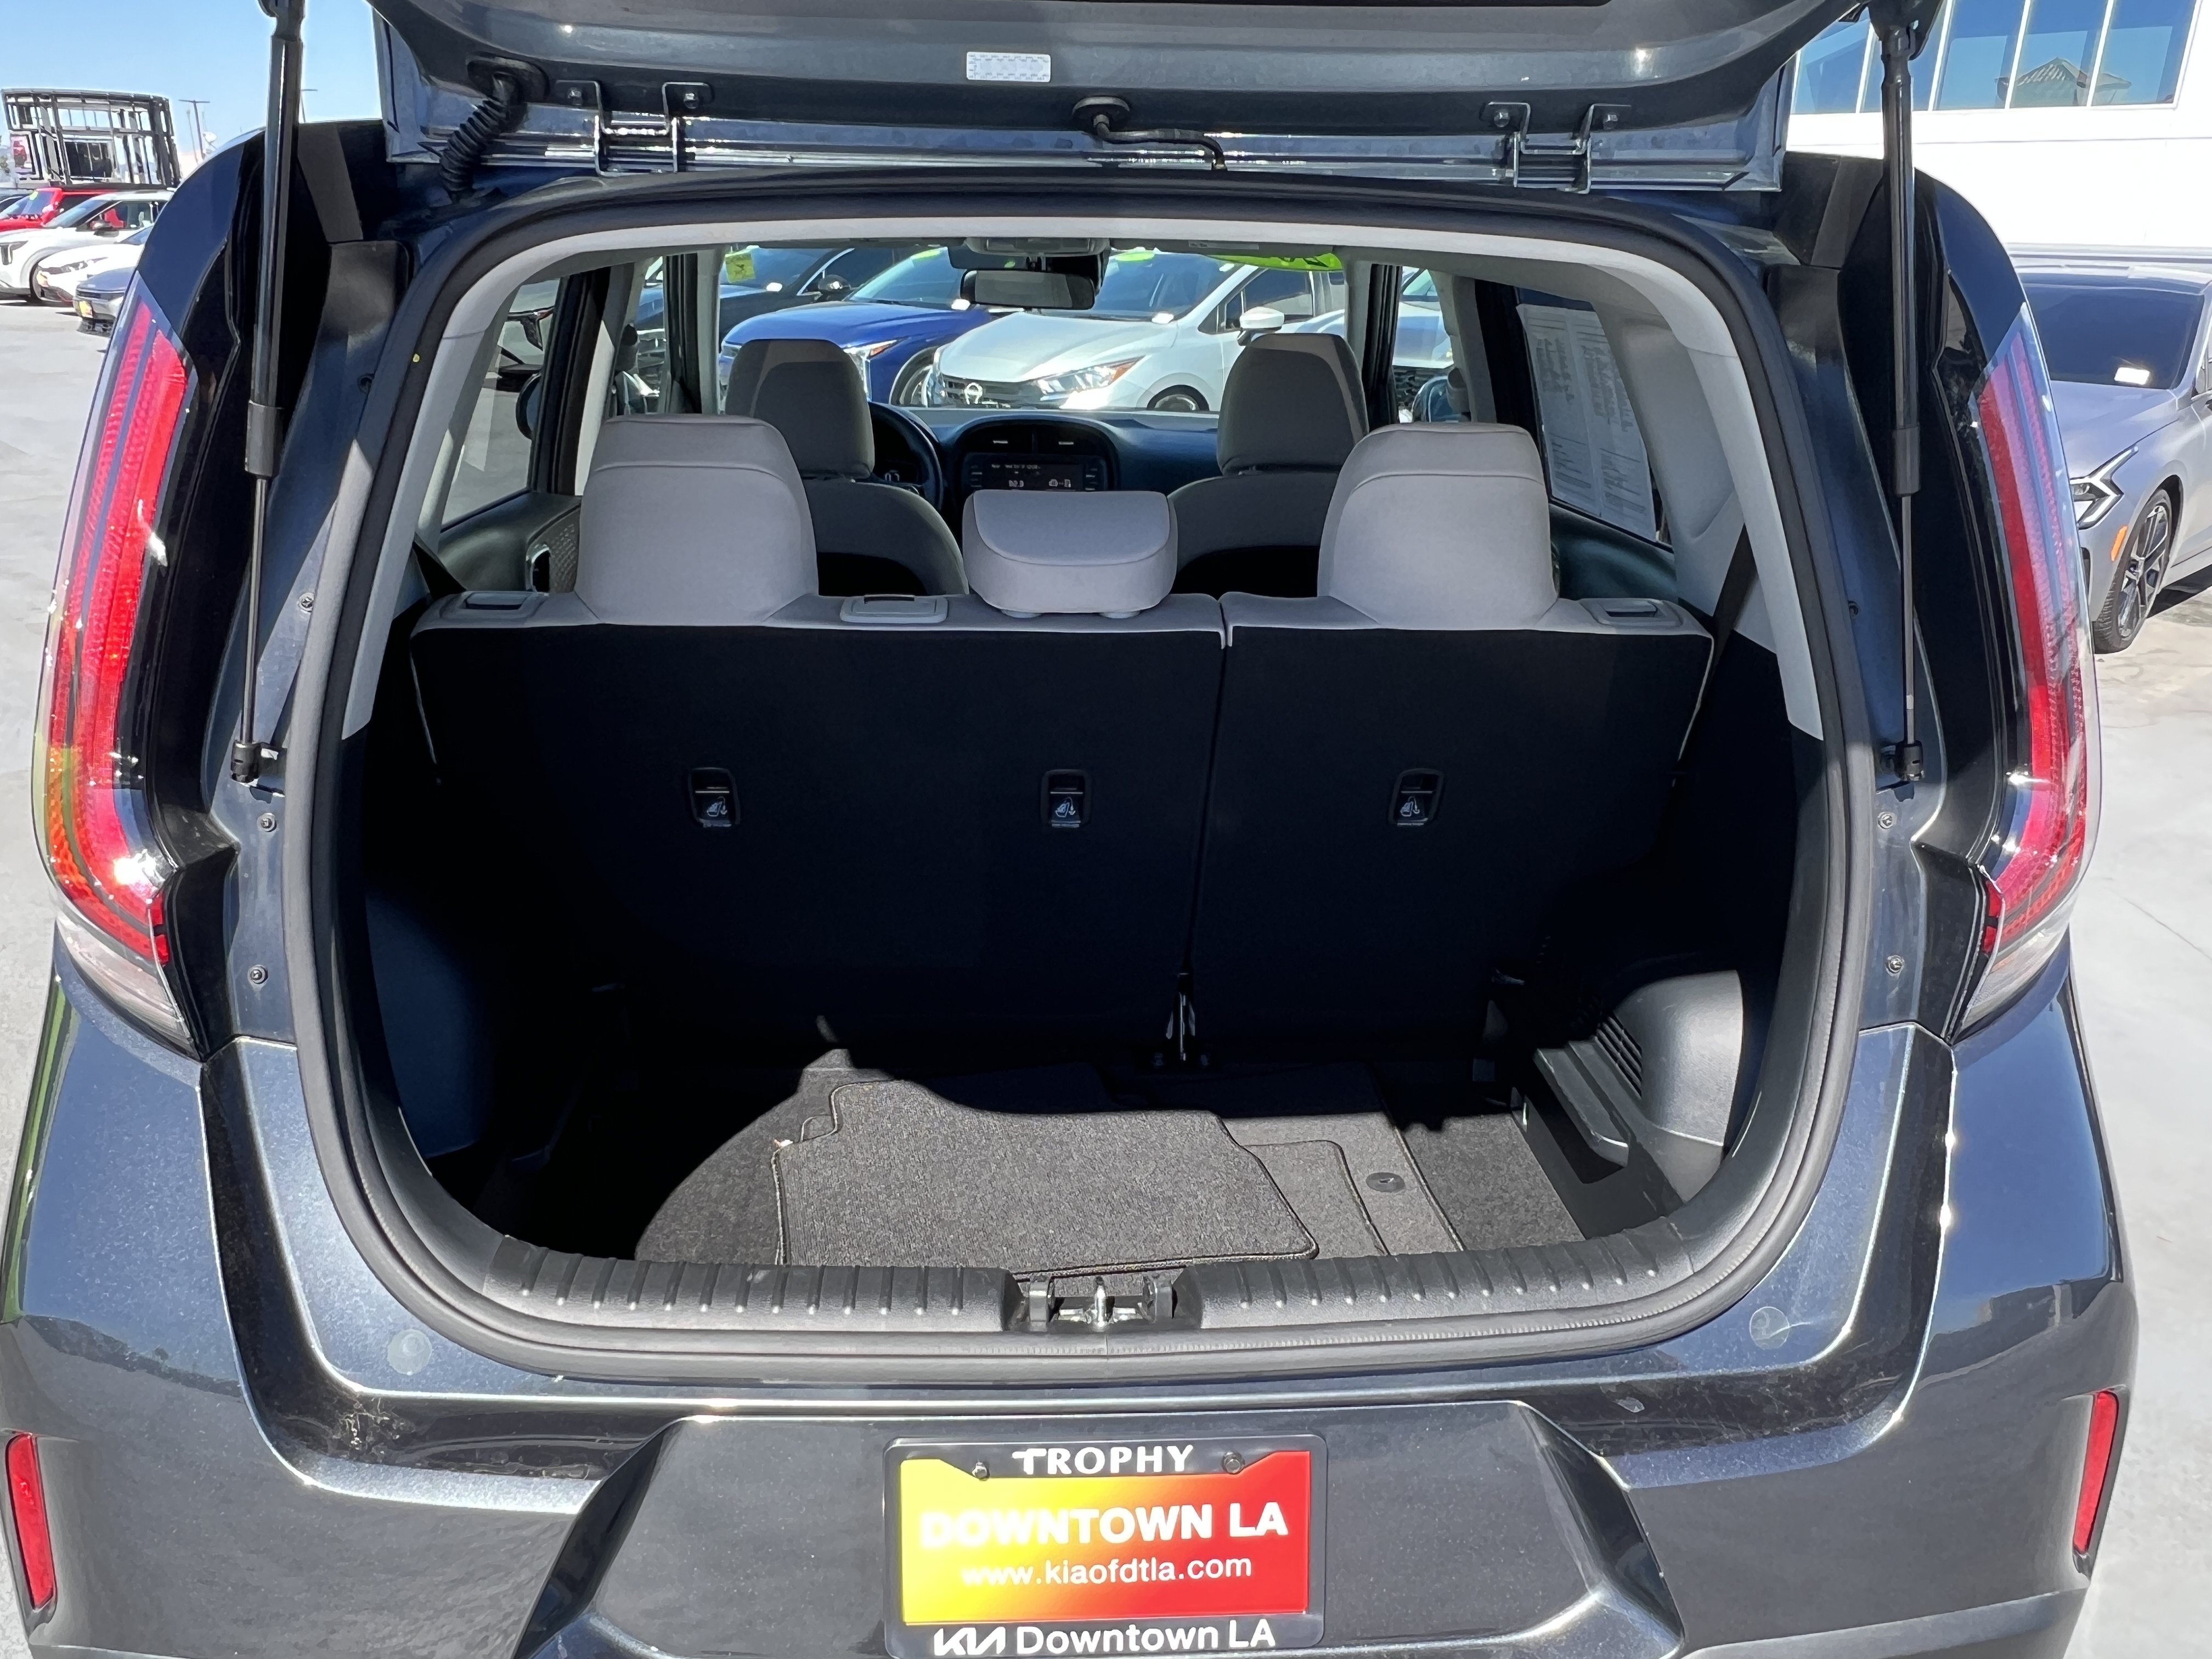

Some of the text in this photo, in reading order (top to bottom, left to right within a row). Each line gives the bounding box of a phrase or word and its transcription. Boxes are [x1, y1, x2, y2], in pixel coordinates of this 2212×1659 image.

[1013, 1445, 1194, 1474] TROPHY
[919, 1502, 1288, 1549] DOWNTOWN LA
[961, 1556, 1252, 1585] www.kiaofdtla.com
[934, 1618, 1276, 1655] KIA Downtown LA
